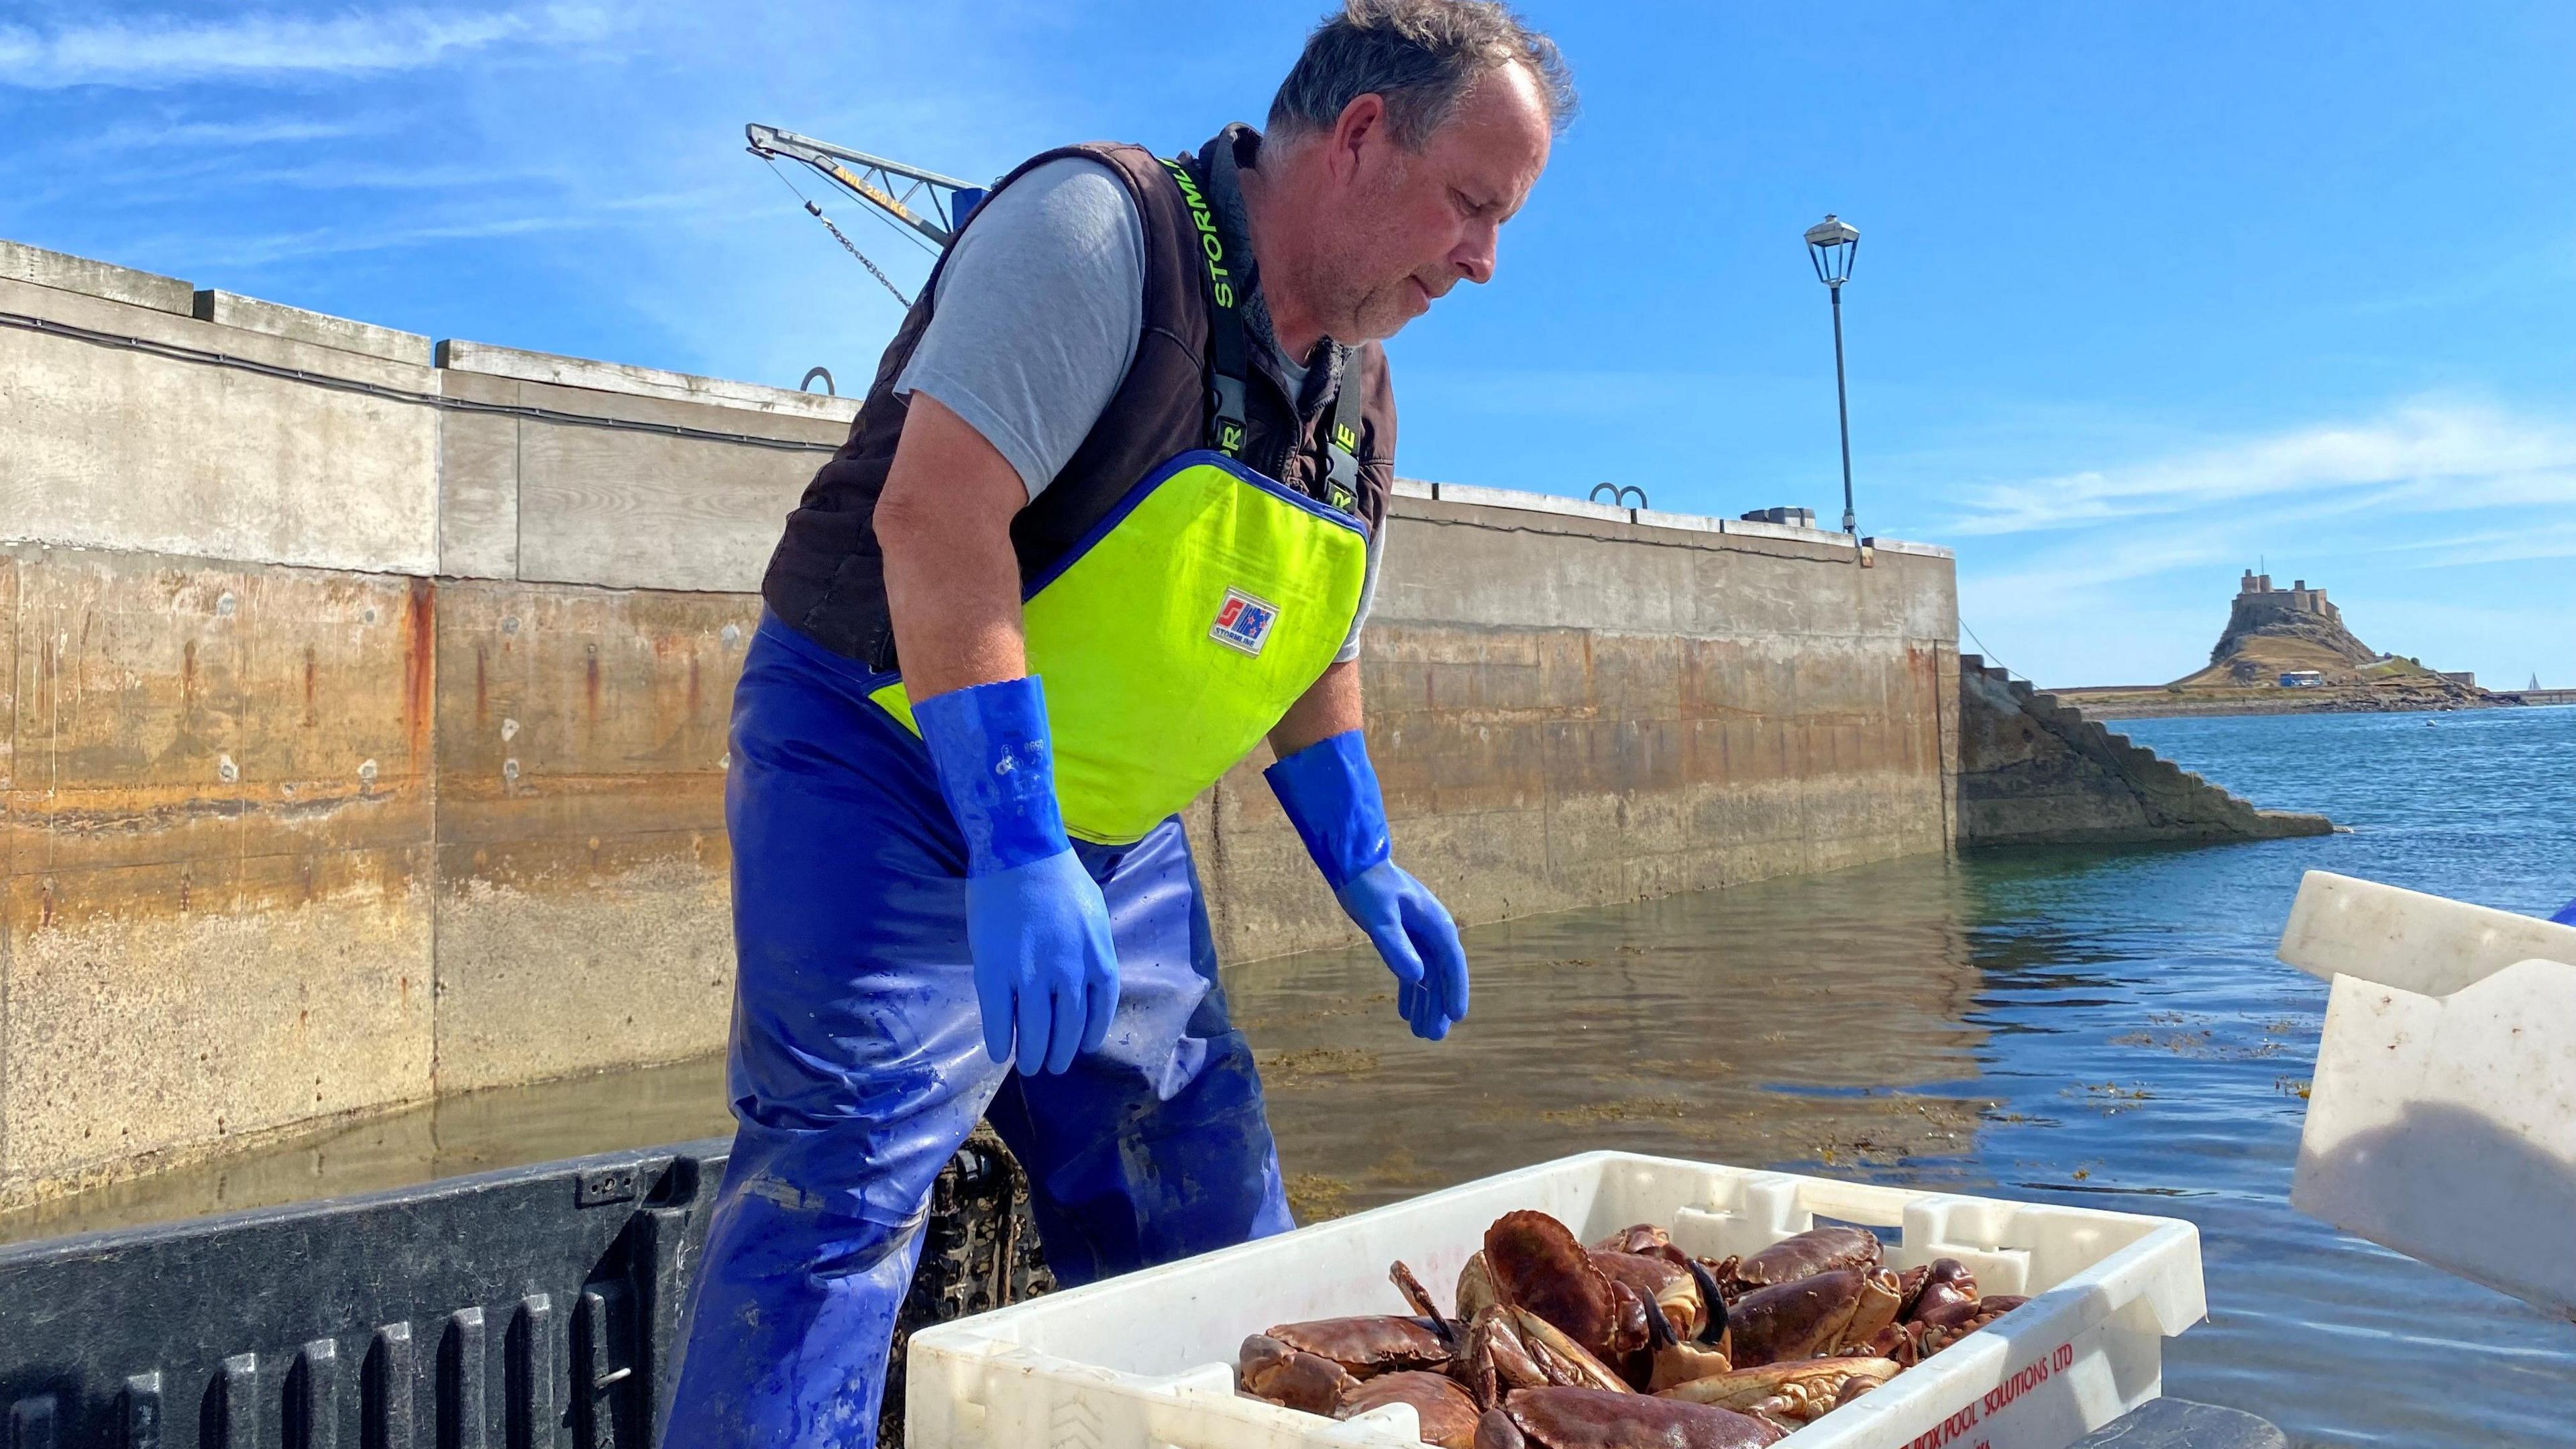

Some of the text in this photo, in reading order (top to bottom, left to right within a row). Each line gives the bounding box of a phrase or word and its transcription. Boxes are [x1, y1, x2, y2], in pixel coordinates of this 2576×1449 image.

[836, 166, 908, 217] SWL 250 KG
[1216, 627, 1256, 647] STORMLINE
[1944, 1401, 1978, 1444] POOL
[1984, 1357, 2048, 1417] SOLUTIONS
[2053, 1343, 2073, 1373] LTD
